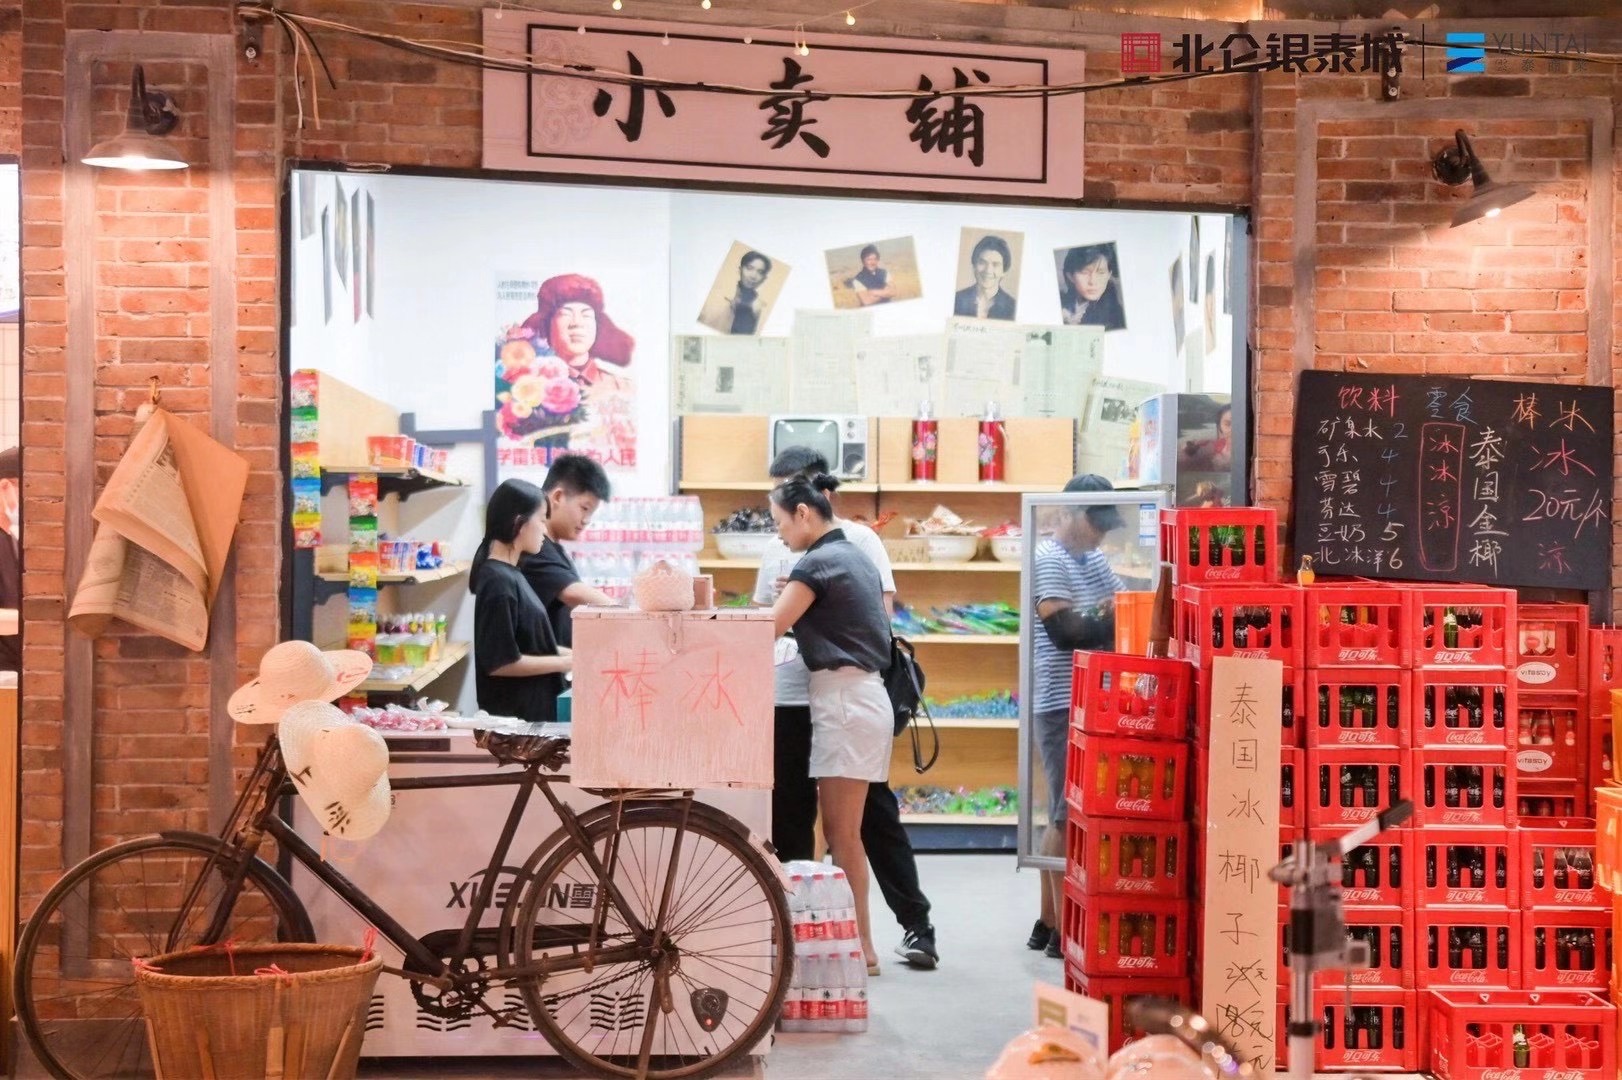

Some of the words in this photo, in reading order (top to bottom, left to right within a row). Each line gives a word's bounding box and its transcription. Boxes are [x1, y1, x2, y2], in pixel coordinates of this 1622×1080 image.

[593, 51, 991, 167] 小卖铺
[1338, 384, 1400, 418] 饮料
[1425, 386, 1479, 426] 零食
[1316, 416, 1384, 441] 矿泉水
[1392, 422, 1409, 439] 2
[1318, 443, 1359, 468] 可乐
[1380, 448, 1400, 463] 4
[1529, 437, 1597, 477] 冰
[1314, 469, 1361, 495] 雪碧
[1379, 473, 1399, 499] 4
[1319, 496, 1361, 520] 芬达
[1377, 502, 1398, 519] 4
[1468, 425, 1510, 579] 泰国金椰
[1522, 488, 1608, 540] 20元/个
[1317, 522, 1366, 543] 豆奶
[1380, 521, 1405, 542] 5
[1312, 545, 1385, 574] 北冰洋
[1389, 547, 1403, 570] 6
[1338, 649, 1379, 661] 可口可乐
[1433, 650, 1474, 663] 可口可乐
[1520, 667, 1552, 677] vitasoy
[600, 647, 745, 731] 棒冰
[1338, 730, 1378, 744] 可口可乐
[1517, 756, 1548, 766] vitasoy
[1218, 682, 1265, 946] 泰国冰椰子
[1341, 808, 1379, 821] 可口可乐
[1442, 810, 1482, 823] 可口可乐
[1115, 878, 1155, 891] 可口可乐
[1446, 888, 1486, 902] 可口可乐
[1555, 890, 1593, 903] 可口可乐
[1117, 955, 1157, 969] 可口可乐
[1557, 970, 1594, 985] 可口可乐
[1343, 1050, 1381, 1063] 可口可乐
